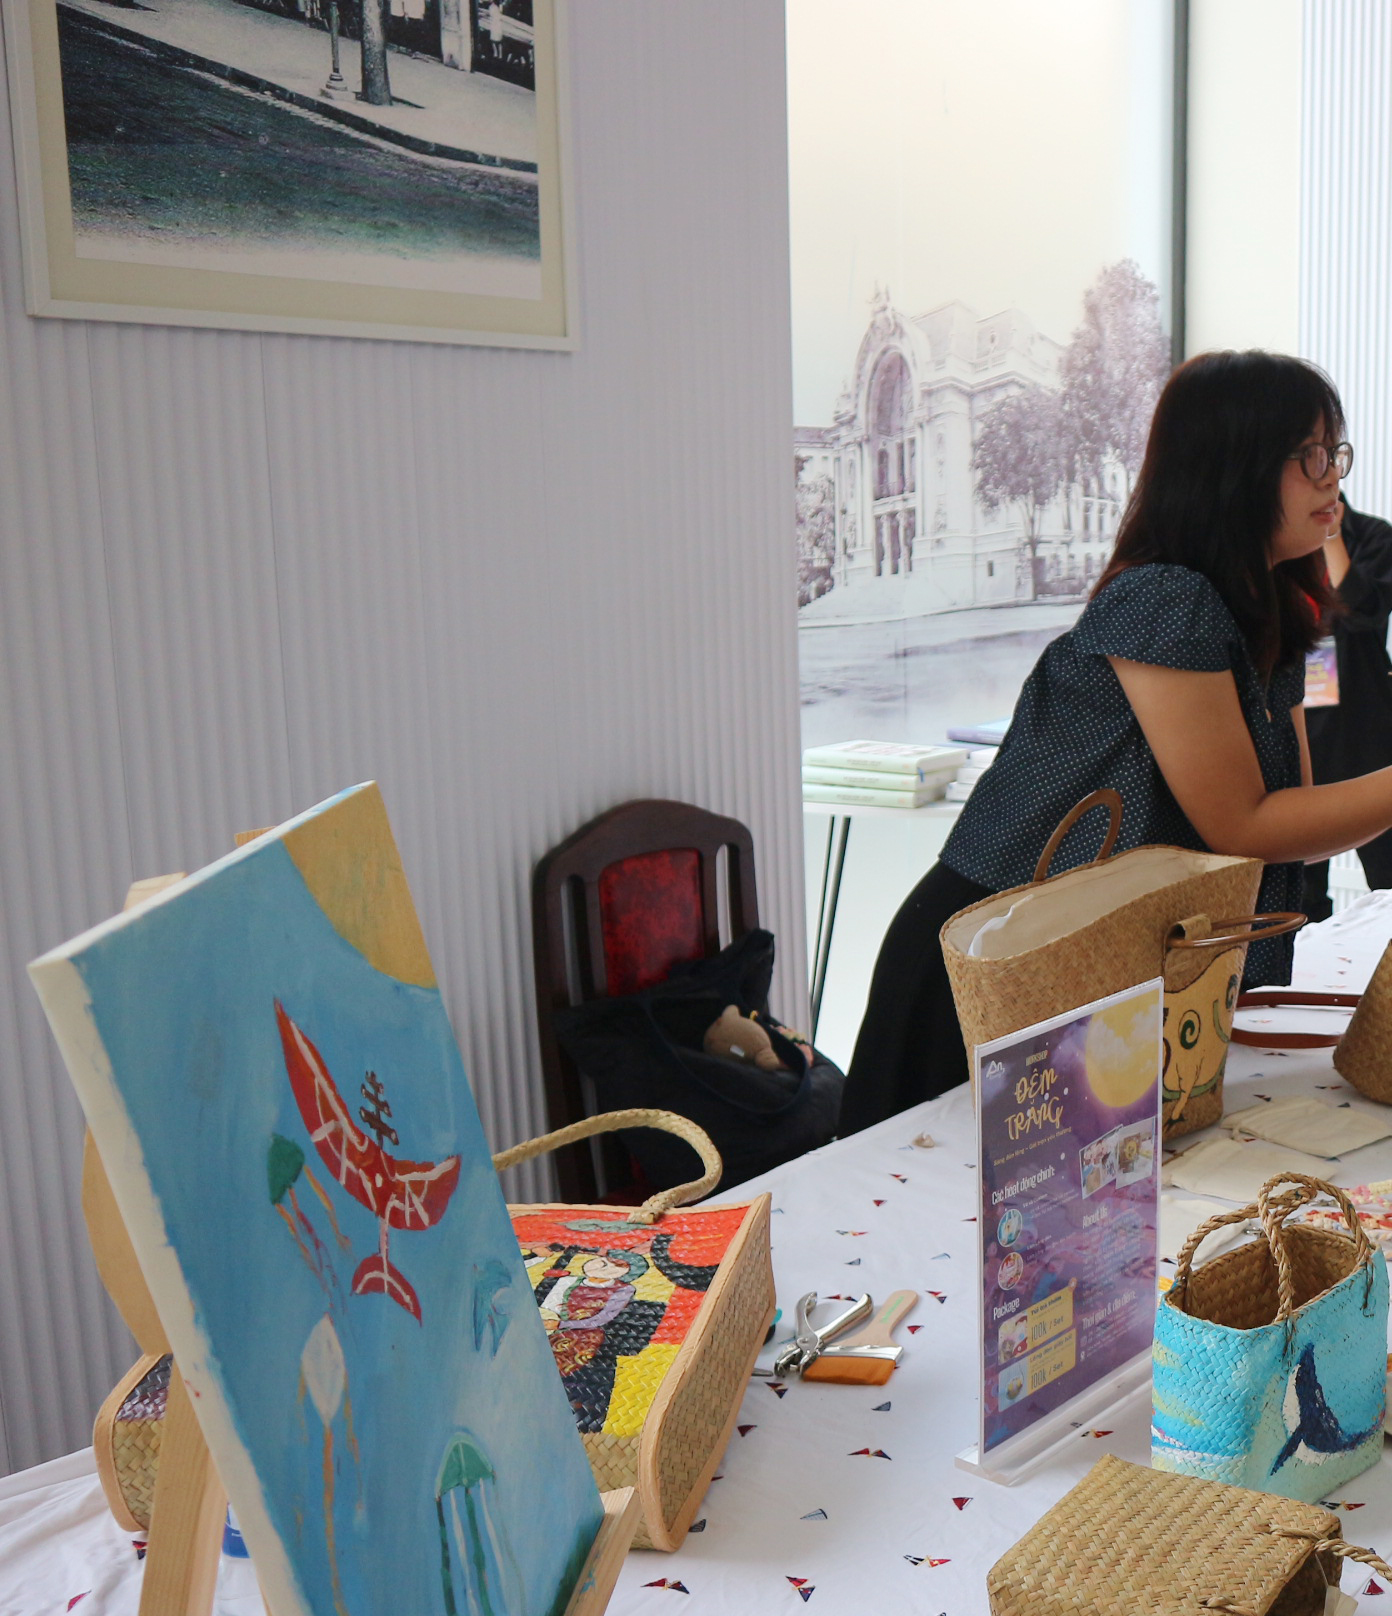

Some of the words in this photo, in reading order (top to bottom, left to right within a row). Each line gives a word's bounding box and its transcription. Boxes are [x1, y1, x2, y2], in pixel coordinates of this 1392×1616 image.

[1025, 1050, 1049, 1067] WORKSHOP
[1014, 1068, 1058, 1104] ĐÊM
[1004, 1096, 1064, 1140] TRĂNG
[991, 1188, 1004, 1206] Các
[1004, 1182, 1020, 1200] hoạt
[1020, 1174, 1036, 1192] động
[1082, 1209, 1099, 1229] About
[993, 1297, 1020, 1321] Package
[1053, 1361, 1064, 1373] Set
